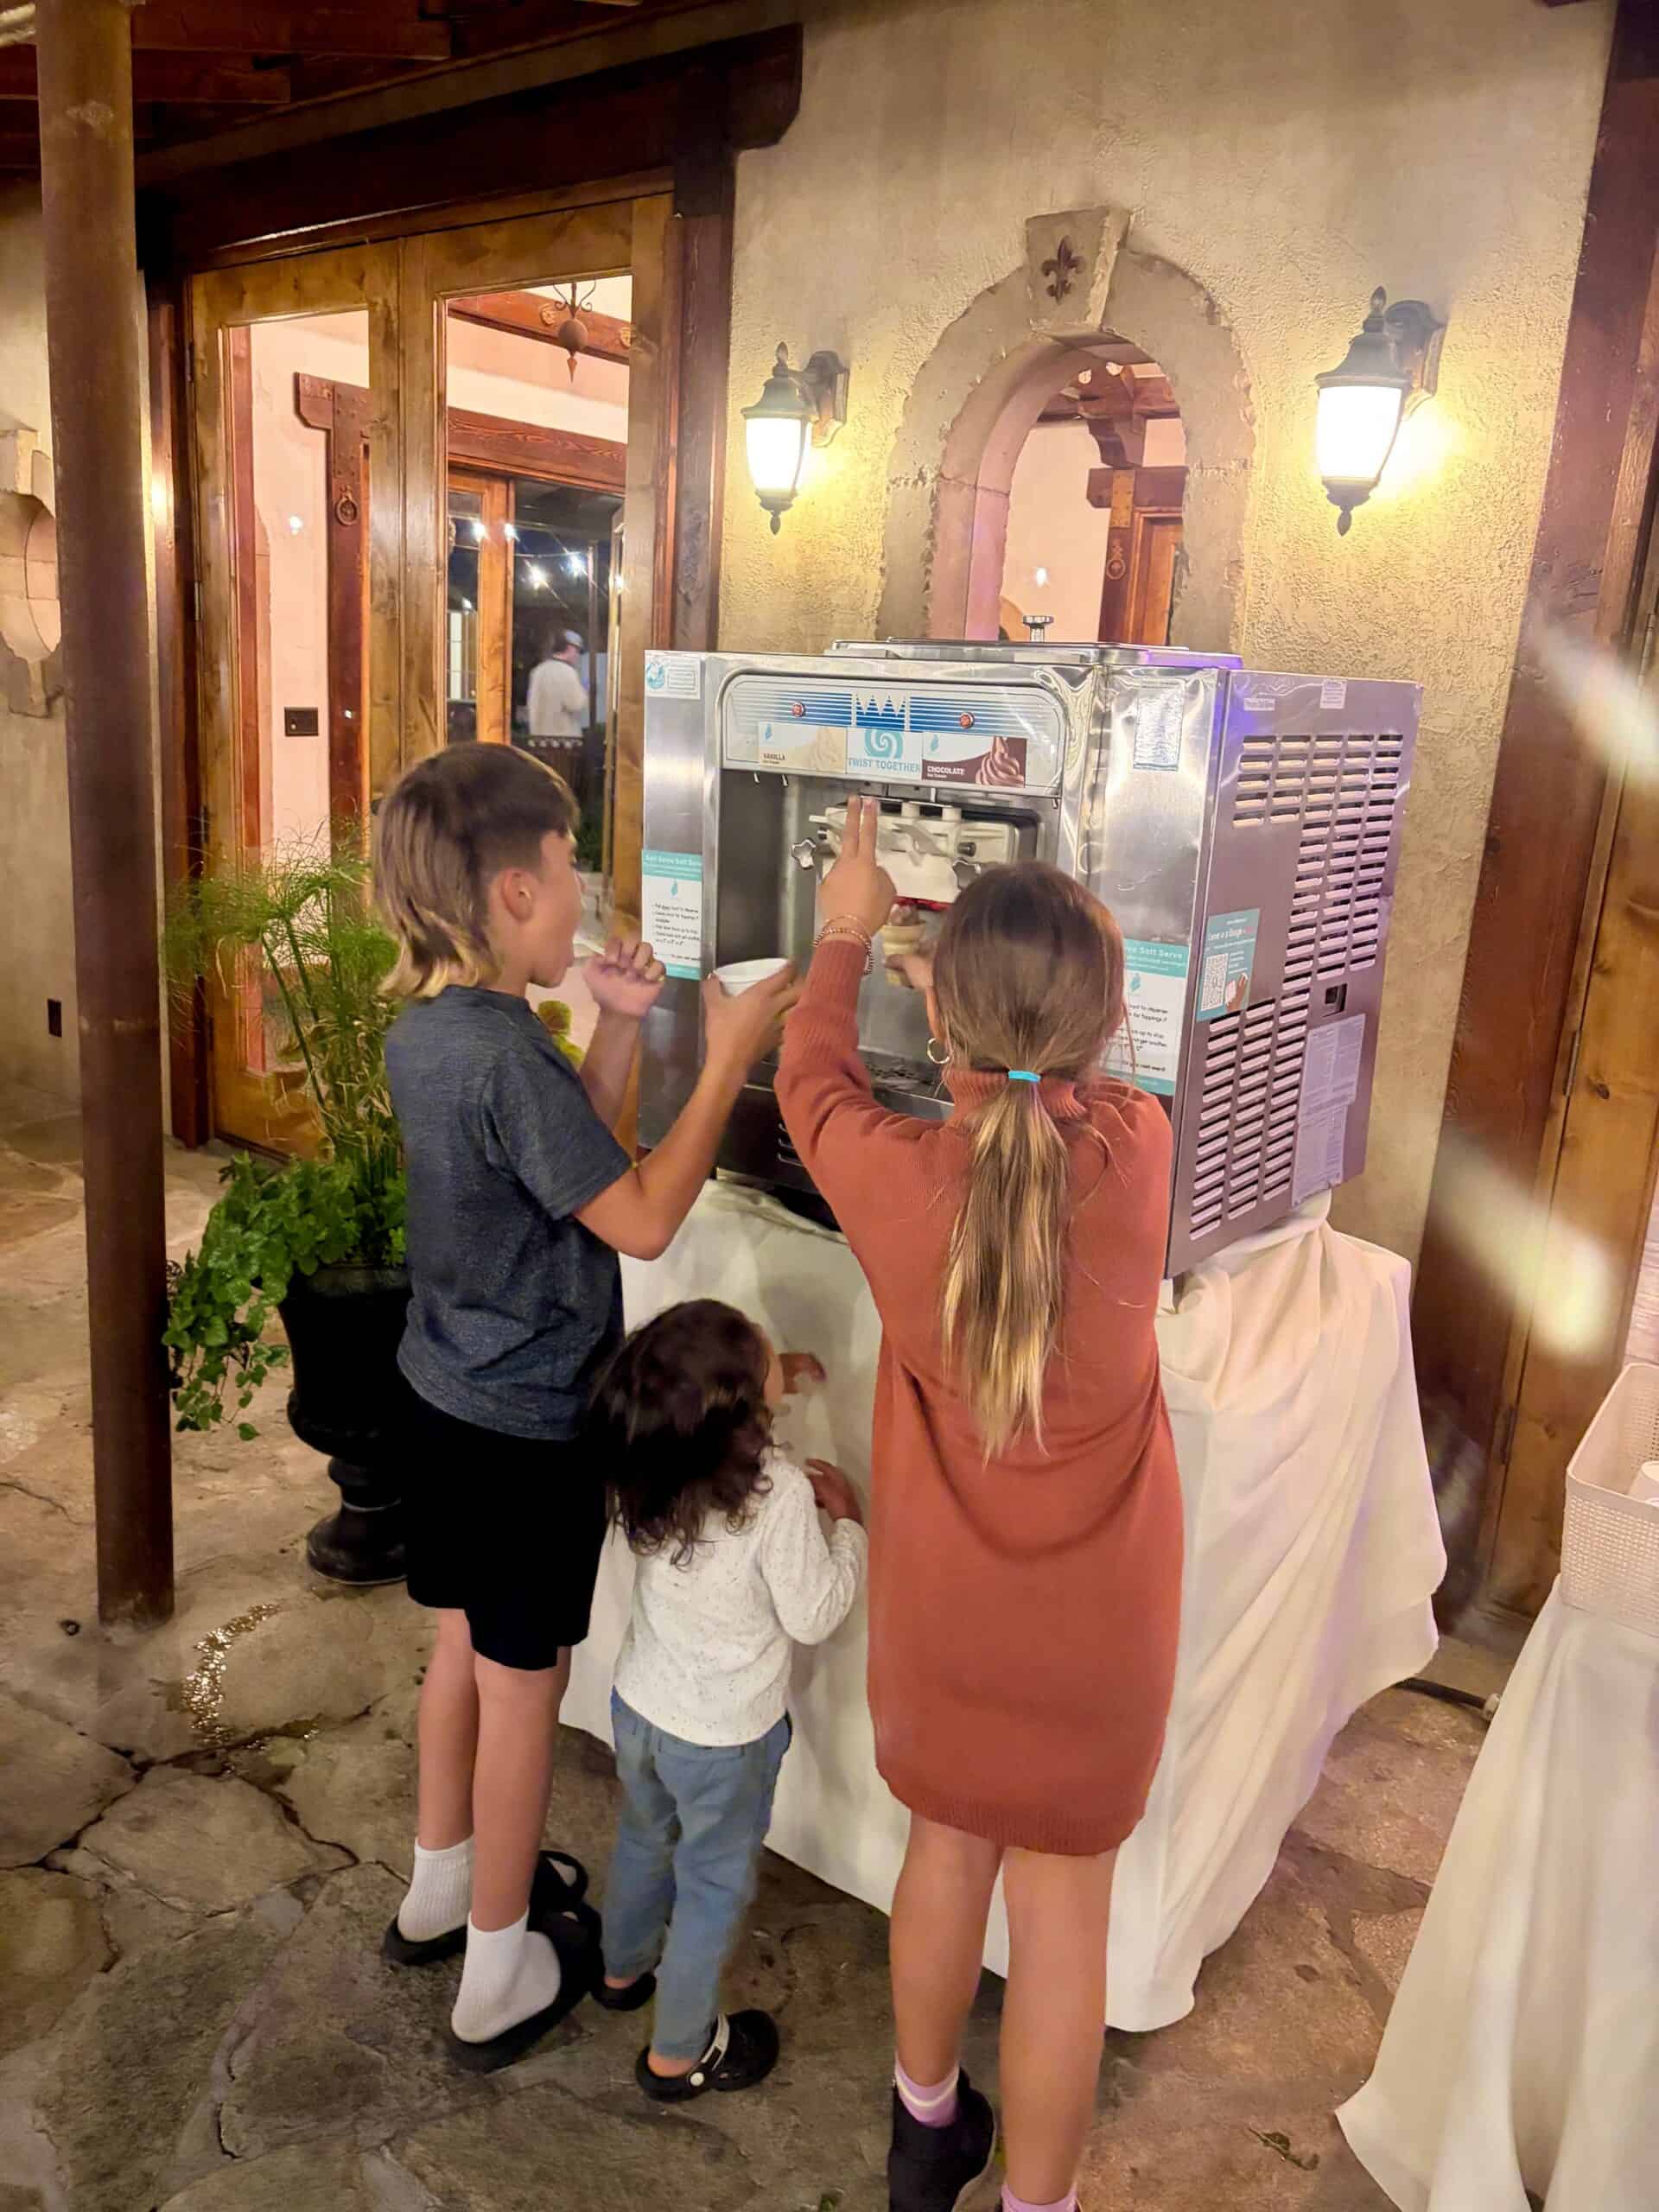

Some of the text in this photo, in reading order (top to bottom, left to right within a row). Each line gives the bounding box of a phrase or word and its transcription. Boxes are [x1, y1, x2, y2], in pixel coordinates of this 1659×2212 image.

[762, 753, 785, 761] VANILLA
[849, 758, 921, 773] TWIST TOGETHER
[927, 765, 965, 776] CHOCOLATE
